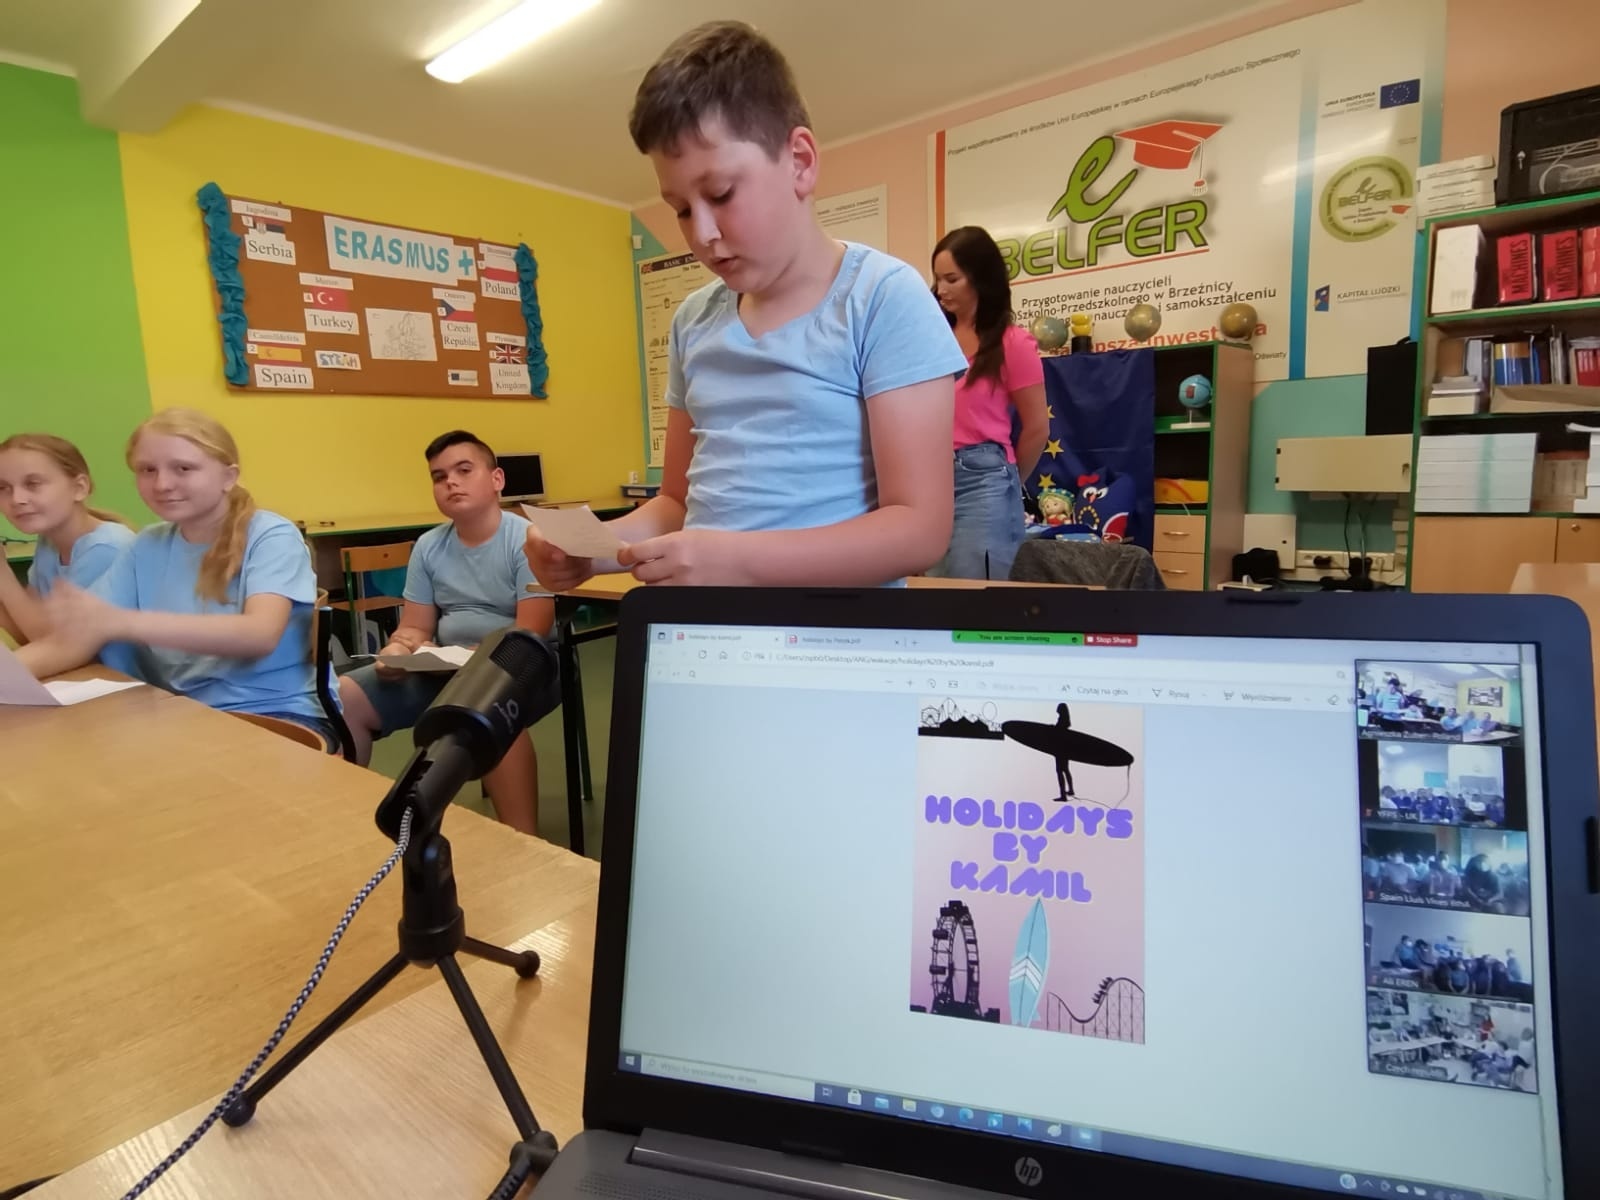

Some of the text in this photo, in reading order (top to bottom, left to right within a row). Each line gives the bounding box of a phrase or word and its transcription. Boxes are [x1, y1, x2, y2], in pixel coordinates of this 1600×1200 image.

[1337, 189, 1393, 208] BELFER
[248, 240, 294, 259] Serbia
[333, 225, 450, 273] ERASMUS
[994, 199, 1209, 281] BELFER
[485, 281, 518, 296] Poland
[1022, 274, 1172, 309] Przygotowanie nauczycieli
[1017, 293, 1150, 321] Szkolno-Przedszkolnego
[1154, 291, 1165, 301] w
[1166, 287, 1277, 312] samokształceniu
[309, 313, 354, 332] Turkey
[446, 322, 472, 333] Czech
[444, 335, 478, 348] Republic
[261, 367, 308, 387] Spain
[498, 369, 522, 378] United
[495, 382, 529, 391] Kingdom
[1027, 635, 1051, 643] sharing
[1095, 636, 1111, 645] Stop
[925, 794, 1134, 840] HOLIDAYS
[992, 831, 1048, 864] BY
[950, 860, 1093, 903] KAMIL
